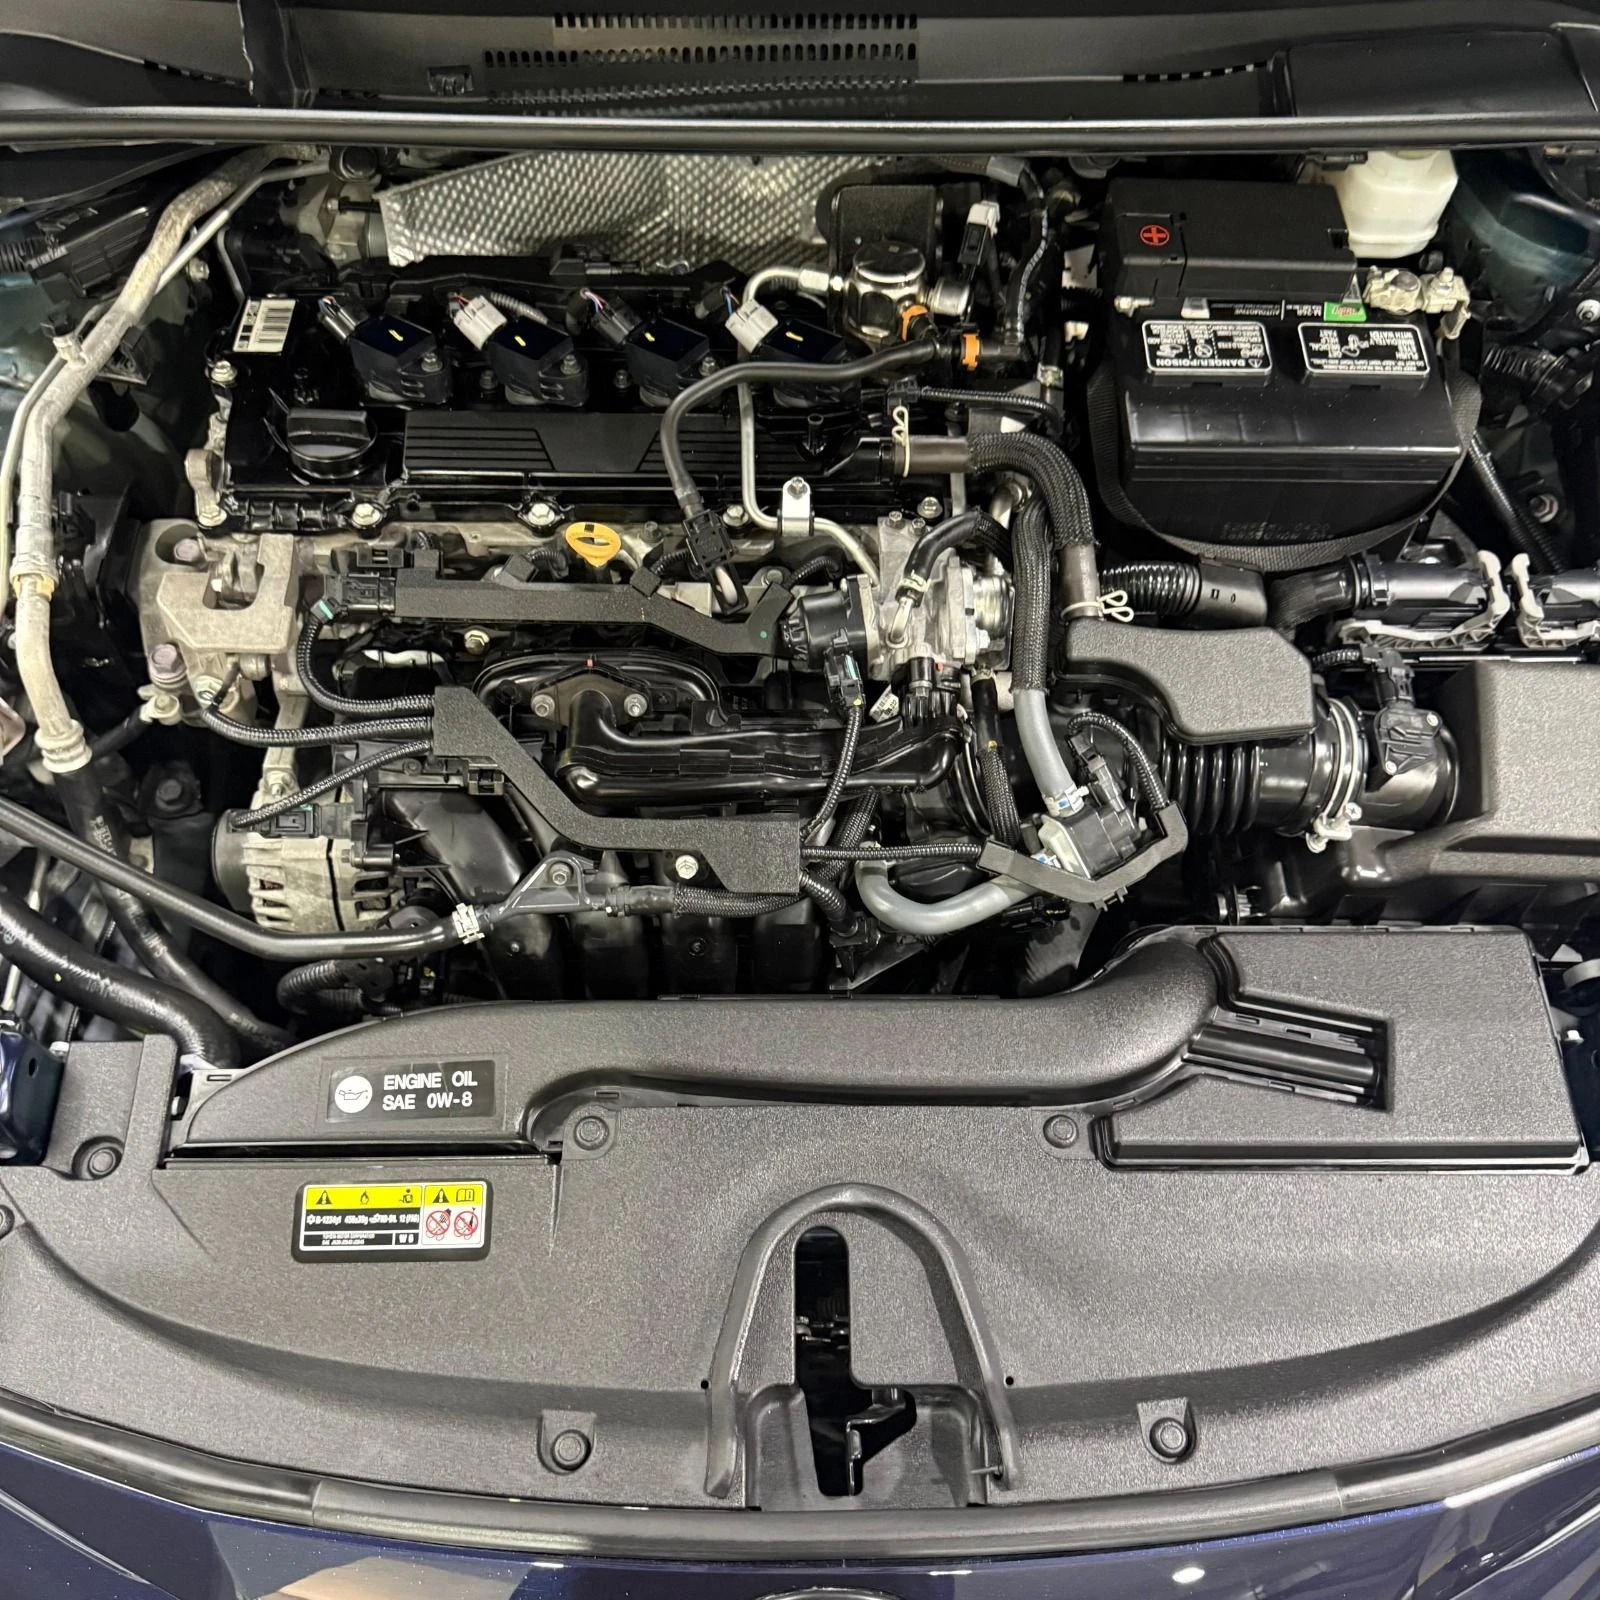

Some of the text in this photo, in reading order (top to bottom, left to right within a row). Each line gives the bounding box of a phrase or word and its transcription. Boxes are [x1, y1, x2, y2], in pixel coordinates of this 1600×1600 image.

[1156, 358, 1246, 367] DANGER/POISON
[384, 1070, 478, 1090] ENGINE OIL
[382, 1092, 472, 1111] SAE 0W-8
